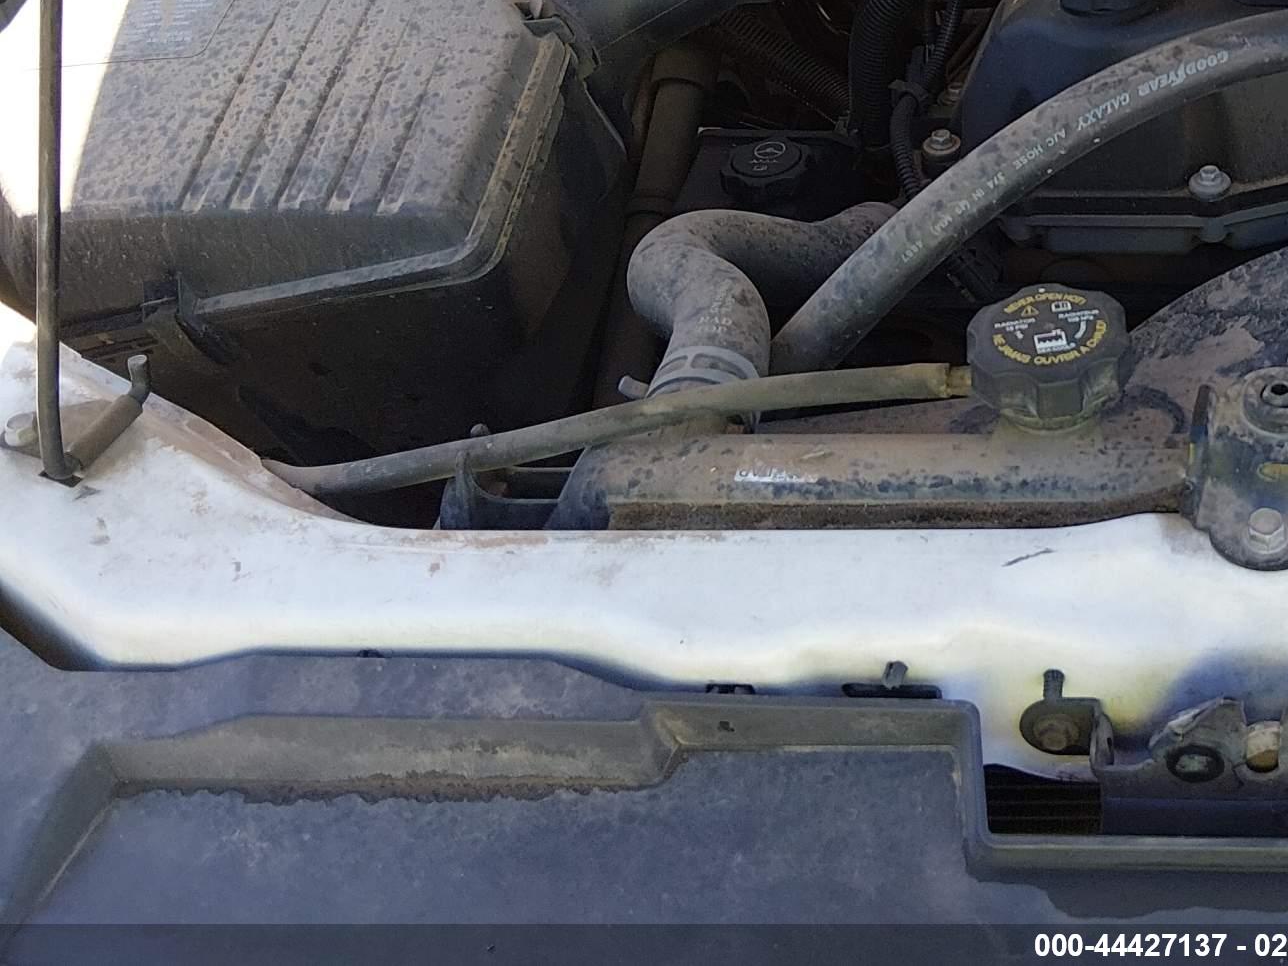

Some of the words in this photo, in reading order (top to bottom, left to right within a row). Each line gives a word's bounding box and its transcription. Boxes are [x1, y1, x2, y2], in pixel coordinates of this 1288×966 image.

[1137, 50, 1229, 96] GOODYEAR
[1077, 91, 1130, 131] GALAXY
[1046, 128, 1066, 147] A/C
[1012, 145, 1043, 170] HOSE
[1003, 296, 1034, 314] NEVER
[1034, 293, 1063, 301] OPEN
[994, 317, 1036, 328] RADIATOR
